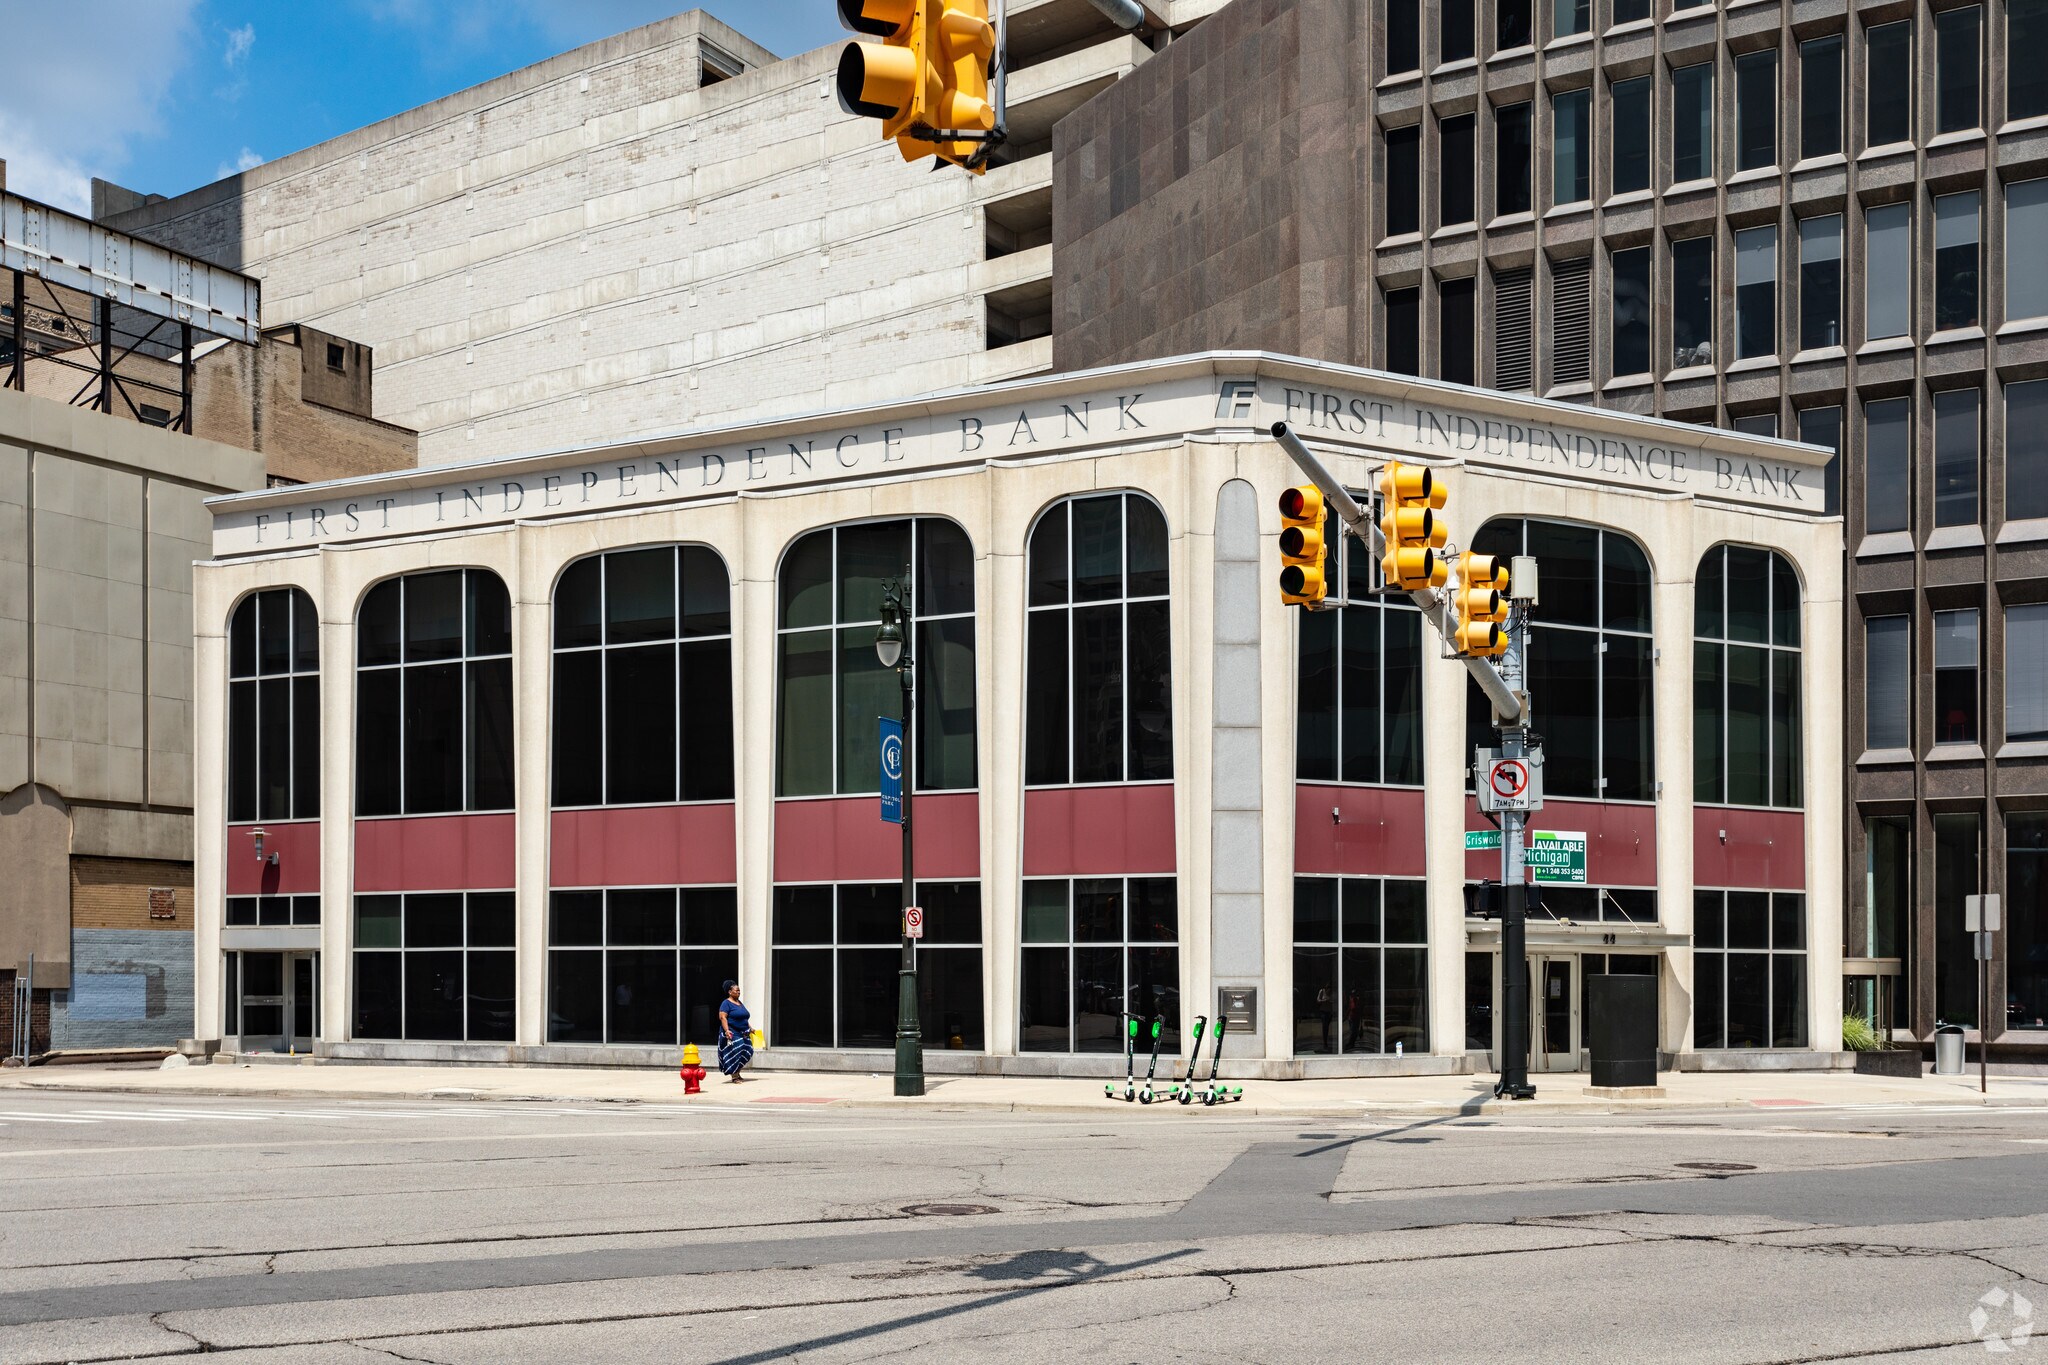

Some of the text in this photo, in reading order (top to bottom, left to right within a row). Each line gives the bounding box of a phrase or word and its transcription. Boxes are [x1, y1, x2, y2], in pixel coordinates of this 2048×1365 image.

[1283, 387, 1803, 502] FIRST INDEPENDENCE BANK
[256, 393, 1148, 544] FIRST INDEPENDENCE BANK
[1466, 835, 1502, 846] Griswold
[1536, 840, 1584, 852] AVAILABLE
[1524, 849, 1569, 866] Michigan
